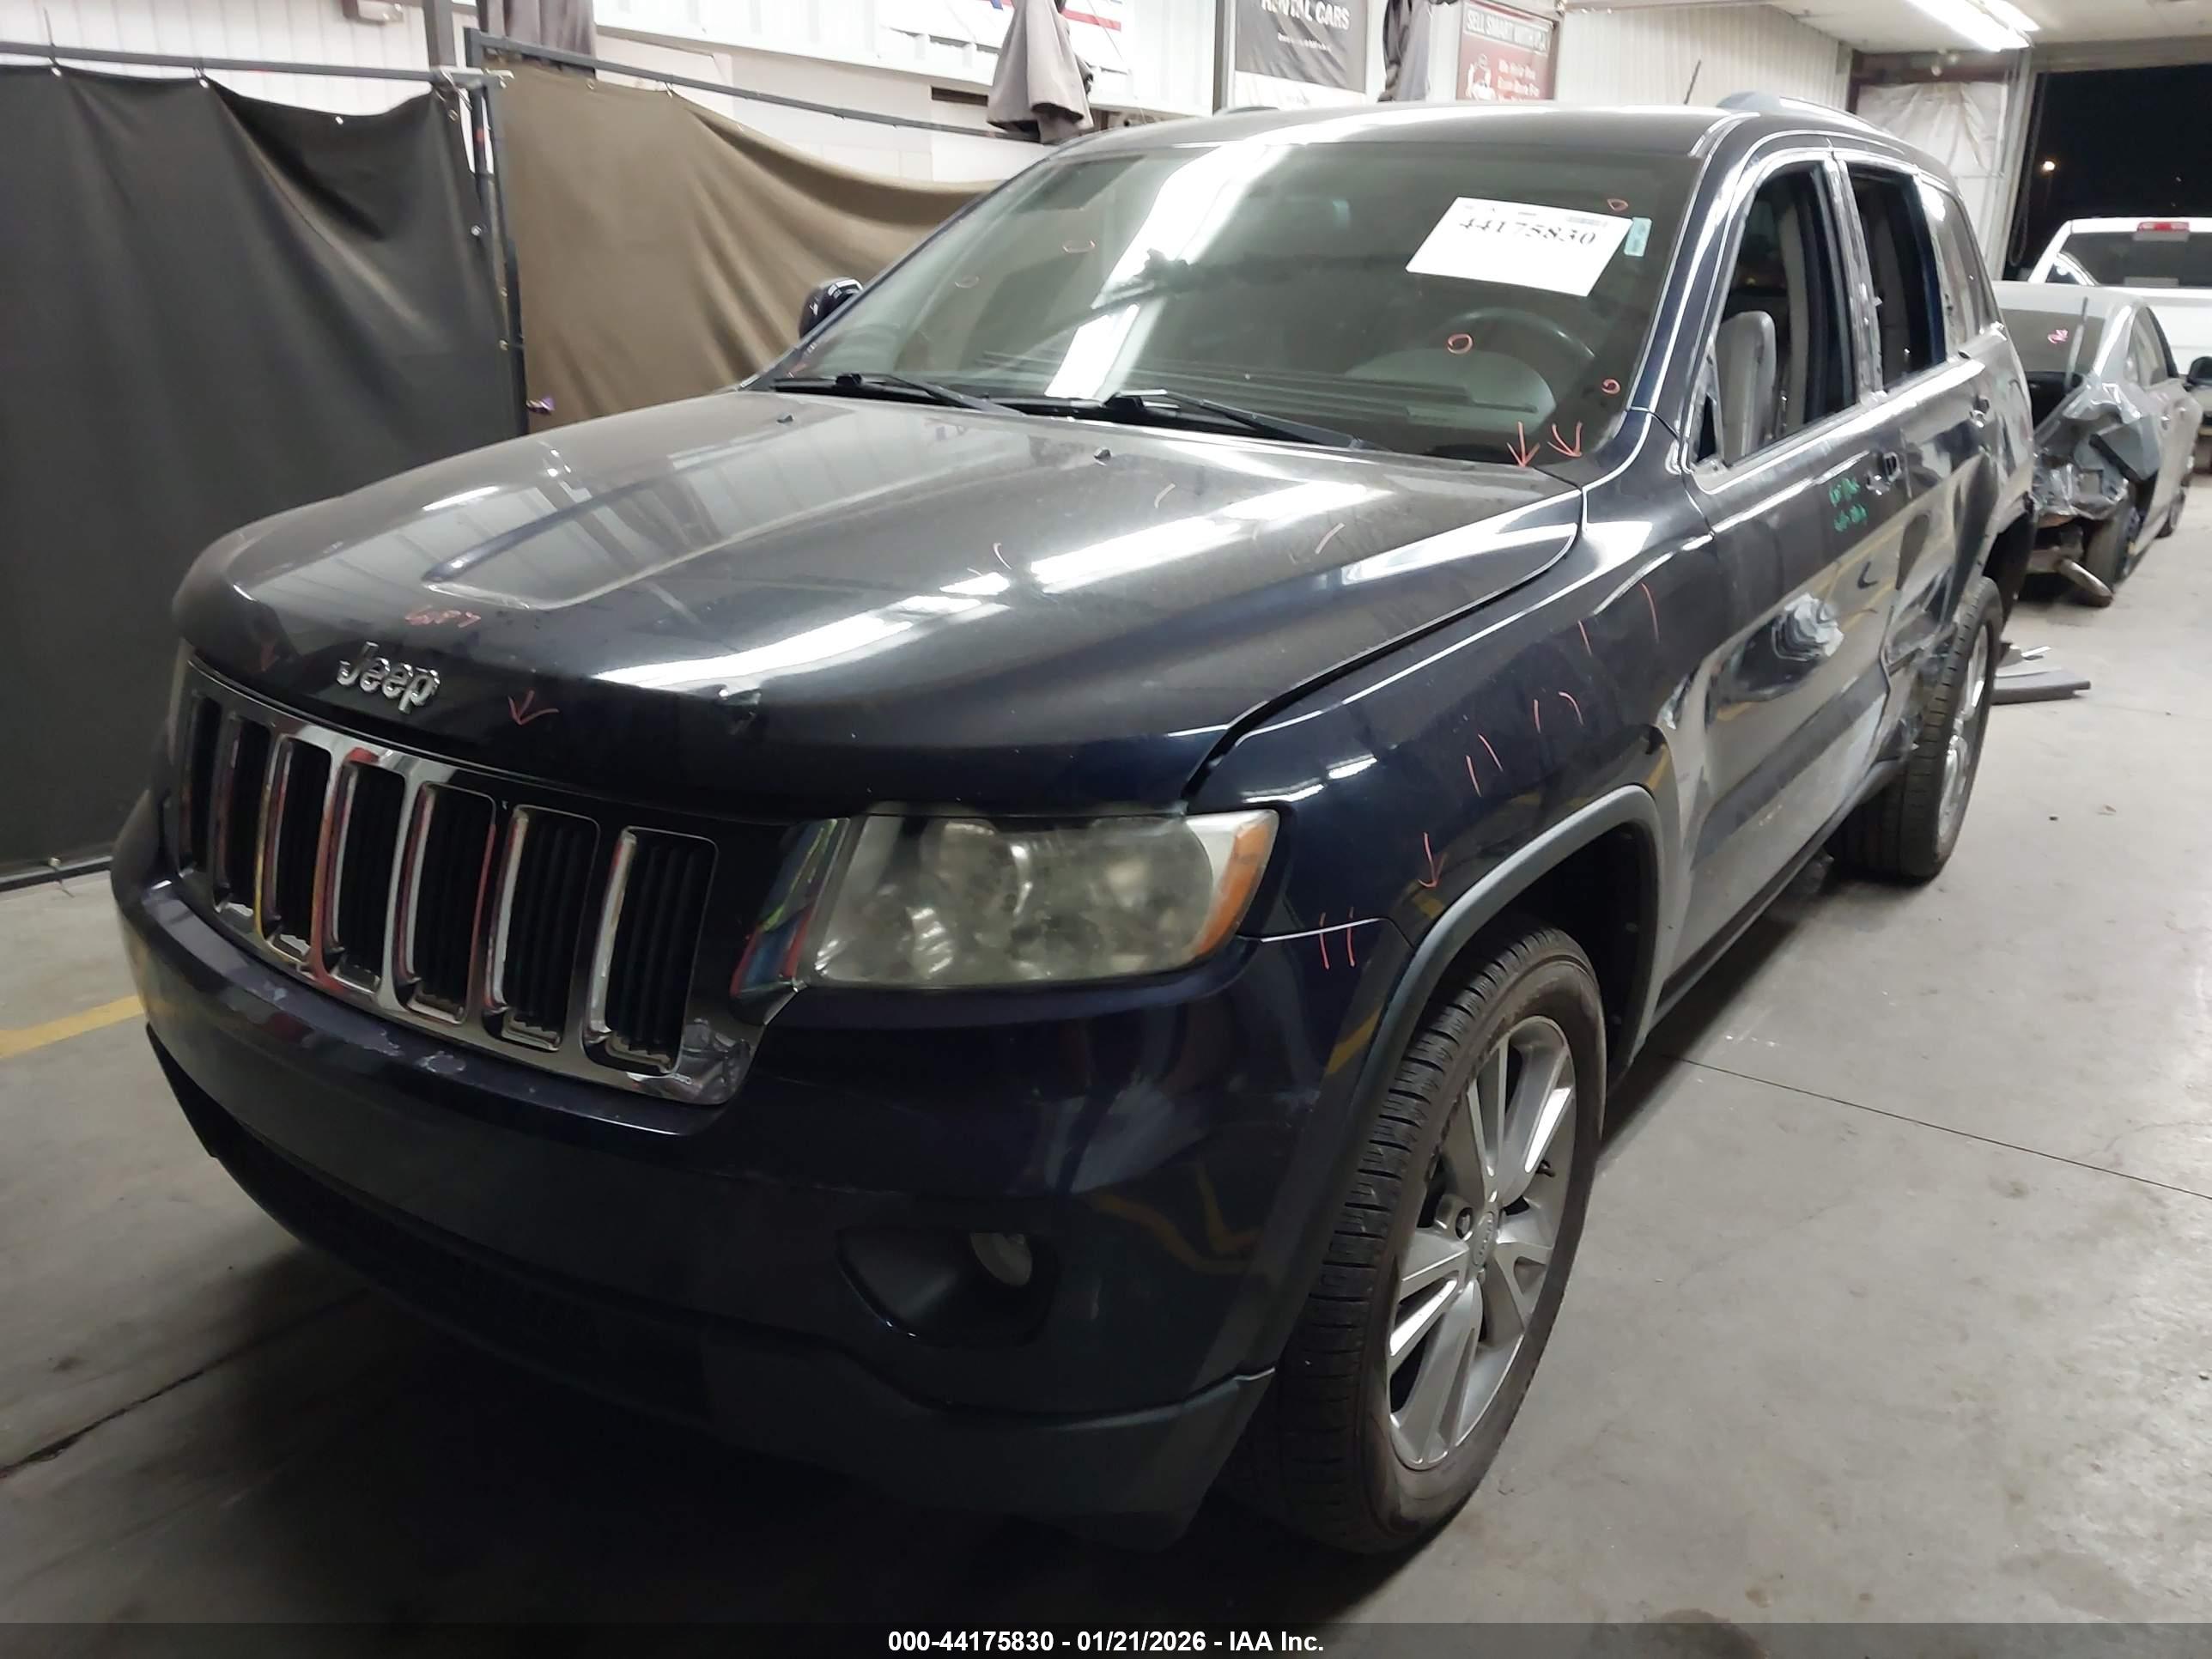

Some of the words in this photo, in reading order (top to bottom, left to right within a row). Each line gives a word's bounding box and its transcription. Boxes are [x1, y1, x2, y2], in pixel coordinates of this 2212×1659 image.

[1316, 1, 1350, 30] CARS
[1459, 217, 1596, 245] 44175830
[336, 641, 441, 714] Jeep
